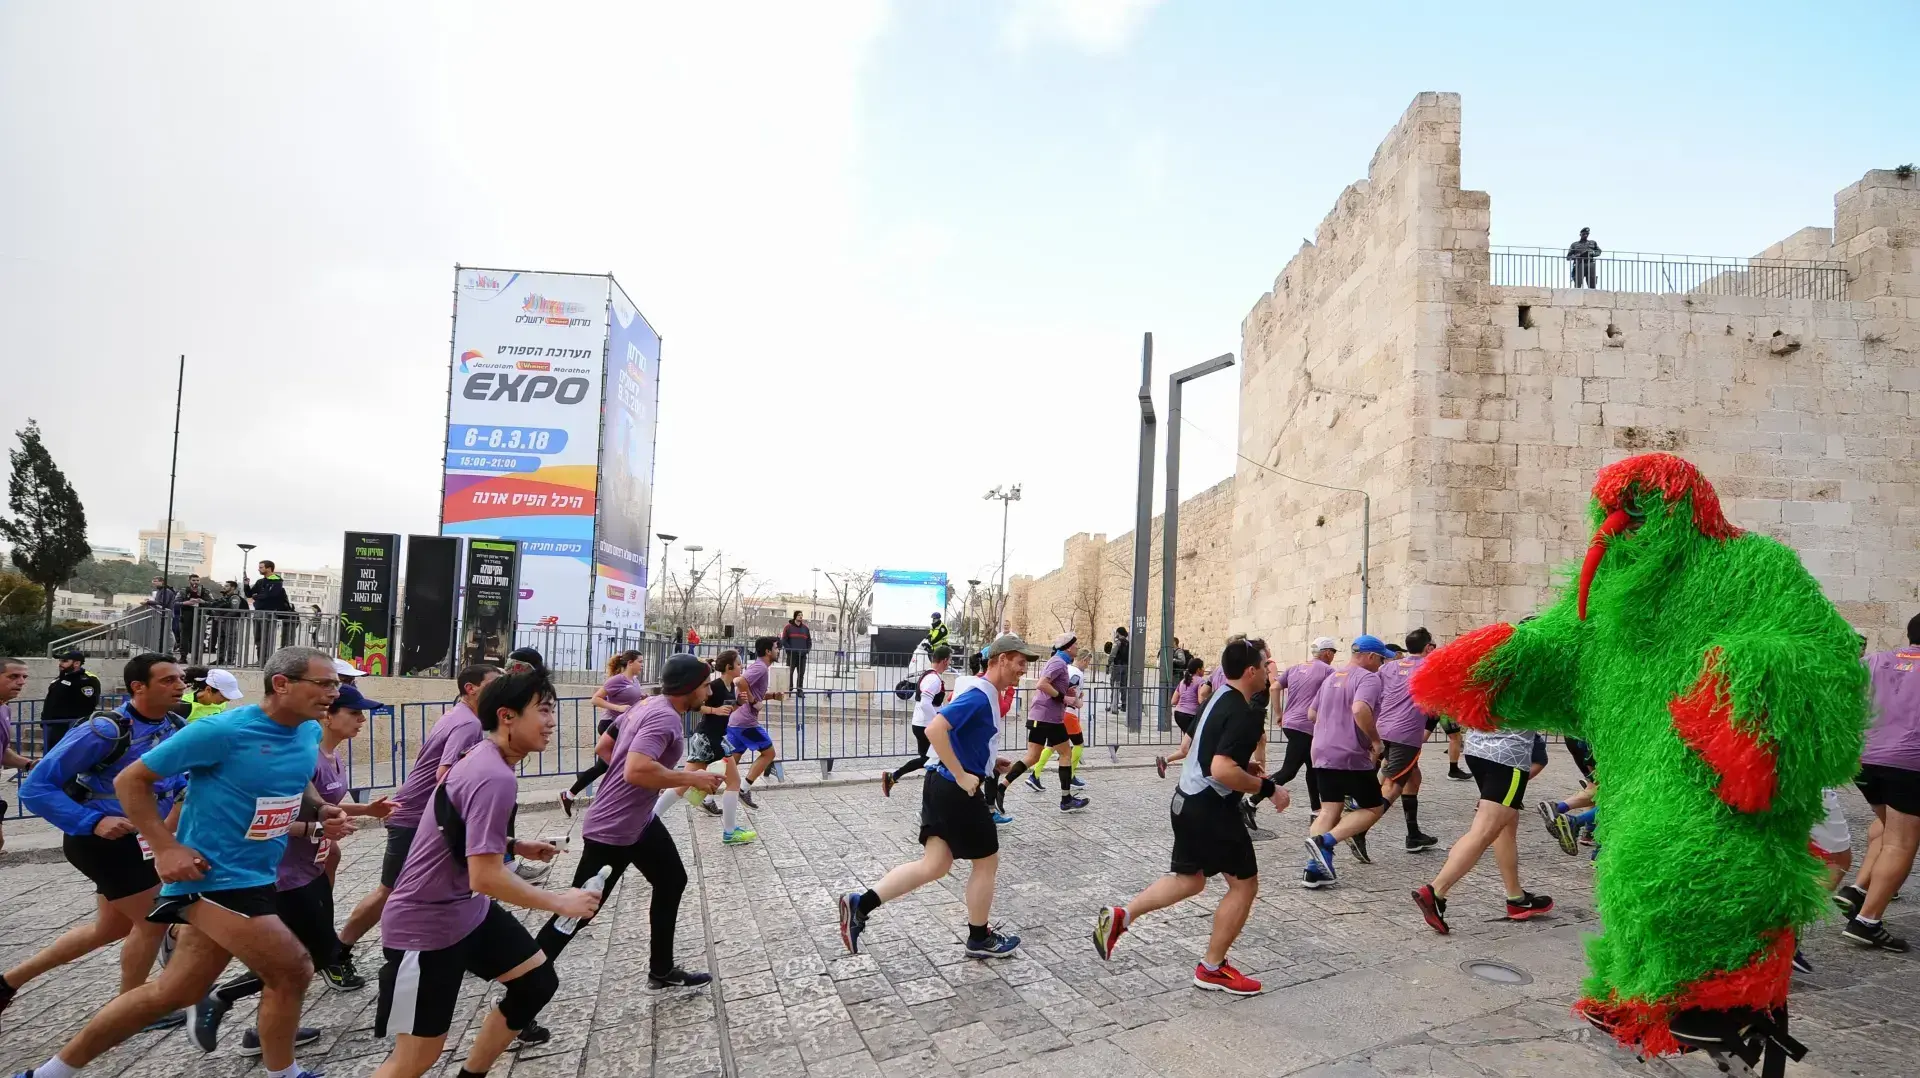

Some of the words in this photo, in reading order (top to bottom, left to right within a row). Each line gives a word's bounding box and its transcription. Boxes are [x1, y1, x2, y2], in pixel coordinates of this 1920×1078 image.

[515, 314, 544, 324] ירושלים
[569, 318, 591, 327] מרתון
[497, 345, 543, 356] הספורט
[546, 347, 592, 359] תערוכת
[523, 362, 549, 370] Winner
[463, 372, 590, 405] EXPO
[460, 457, 517, 468] 15:00-21:00
[472, 491, 509, 505] ארנה
[512, 493, 548, 507] הפיס
[550, 492, 584, 508] היכל
[530, 542, 554, 551] וחניה
[555, 543, 582, 553] כניסה
[360, 568, 375, 579] בואו
[356, 580, 378, 591] לראות
[371, 593, 382, 603] את
[255, 816, 264, 824] A
